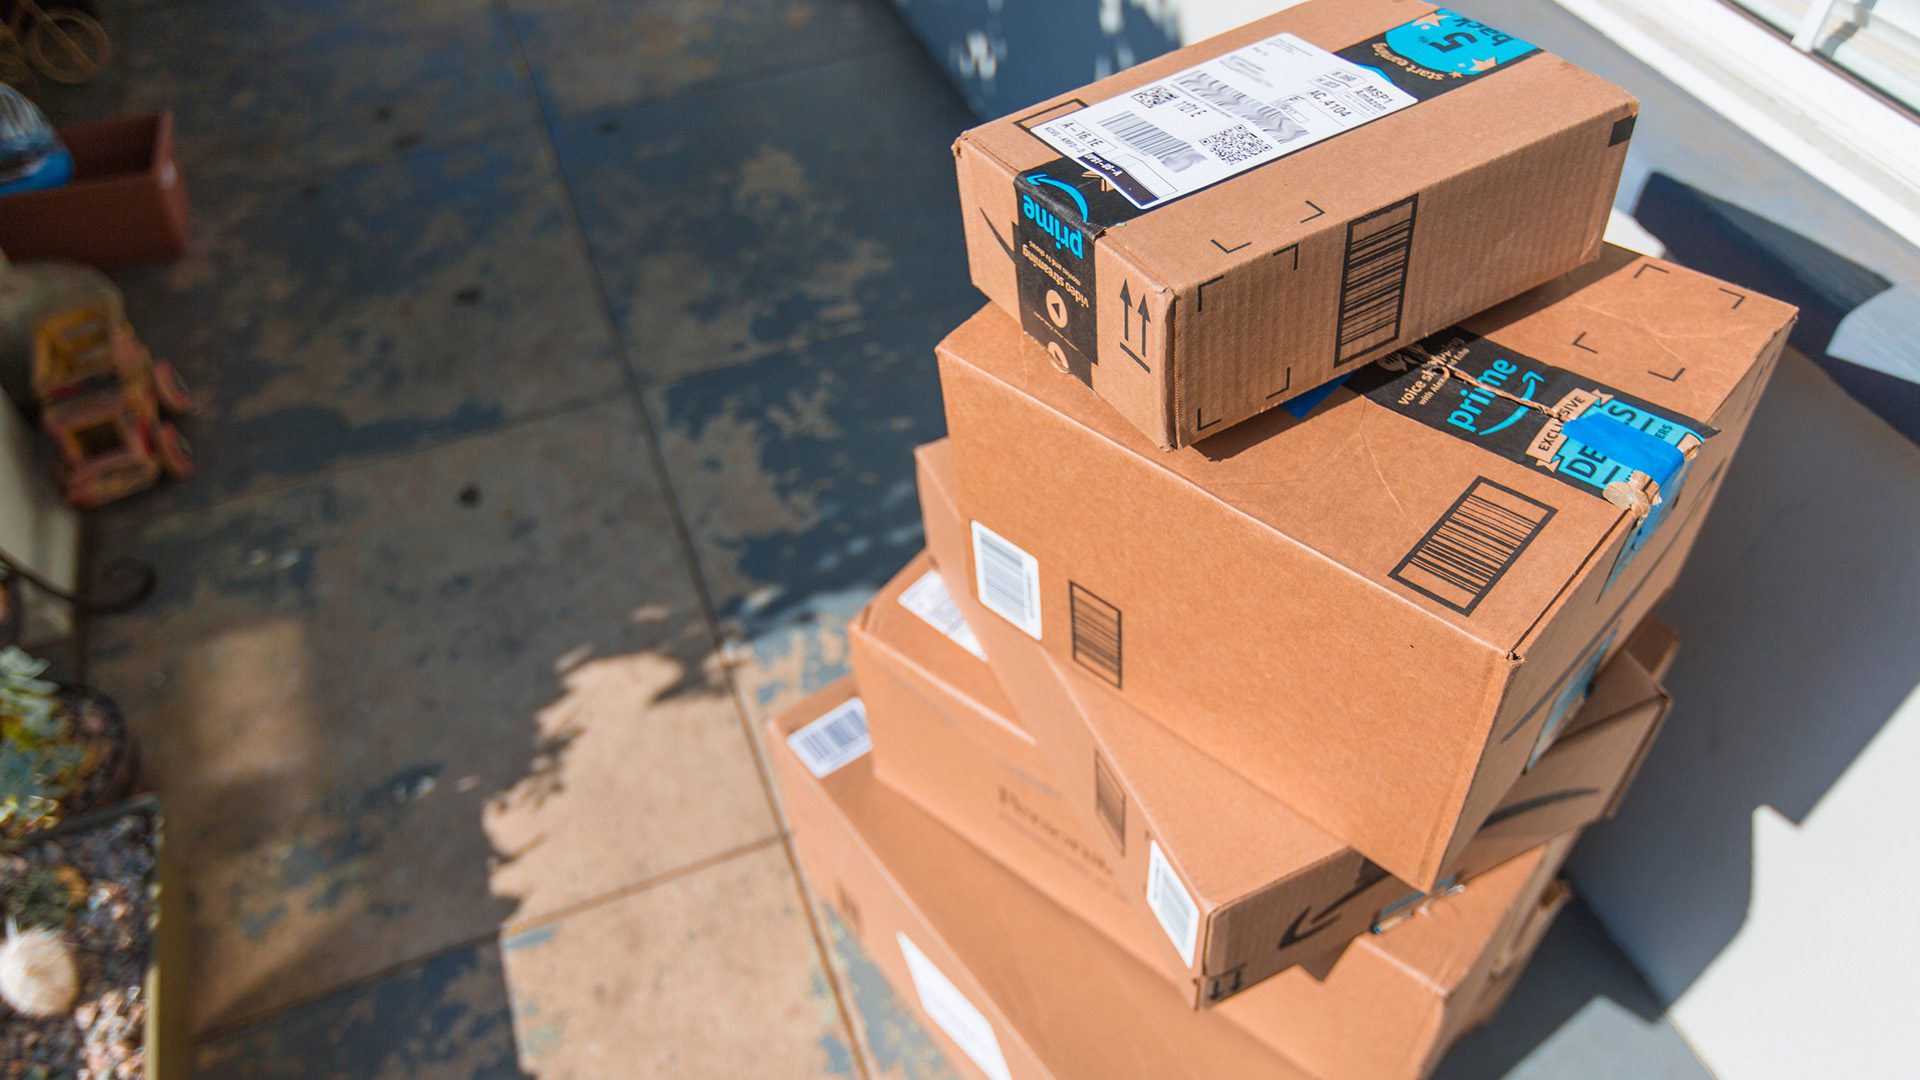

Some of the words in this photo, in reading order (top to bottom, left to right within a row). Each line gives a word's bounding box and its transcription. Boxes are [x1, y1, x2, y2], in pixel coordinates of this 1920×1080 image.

[1452, 17, 1514, 47] back
[1371, 42, 1409, 68] earning
[1404, 62, 1446, 81] start
[1363, 85, 1394, 103] MSP1
[1023, 193, 1084, 260] prime
[1022, 243, 1065, 288] streaming
[1065, 282, 1089, 308] video
[1397, 379, 1427, 406] voice
[1418, 391, 1433, 405] with
[1430, 376, 1448, 394] Alex
[1447, 358, 1519, 433] prime
